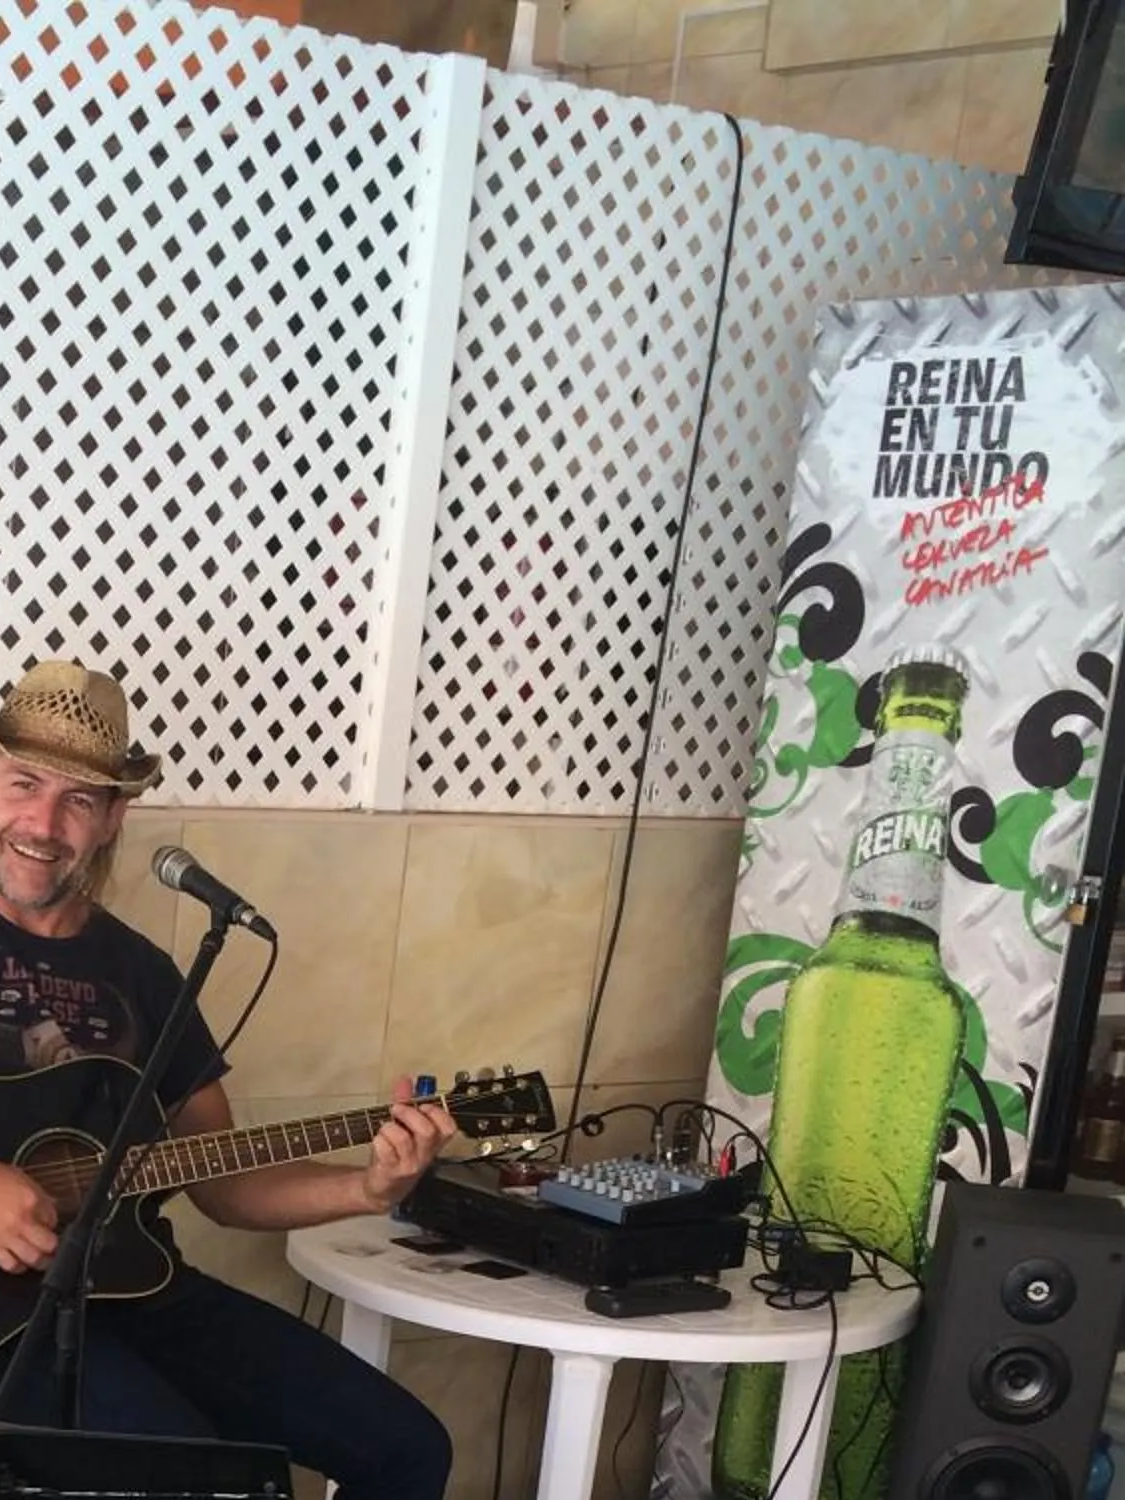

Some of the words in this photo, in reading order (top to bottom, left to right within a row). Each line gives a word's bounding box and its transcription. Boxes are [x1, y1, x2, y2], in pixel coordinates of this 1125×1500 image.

[885, 356, 1026, 406] REINA
[879, 407, 939, 452] EN
[954, 405, 1014, 450] TU
[873, 451, 1050, 499] MUNDO
[853, 813, 942, 867] REINA
